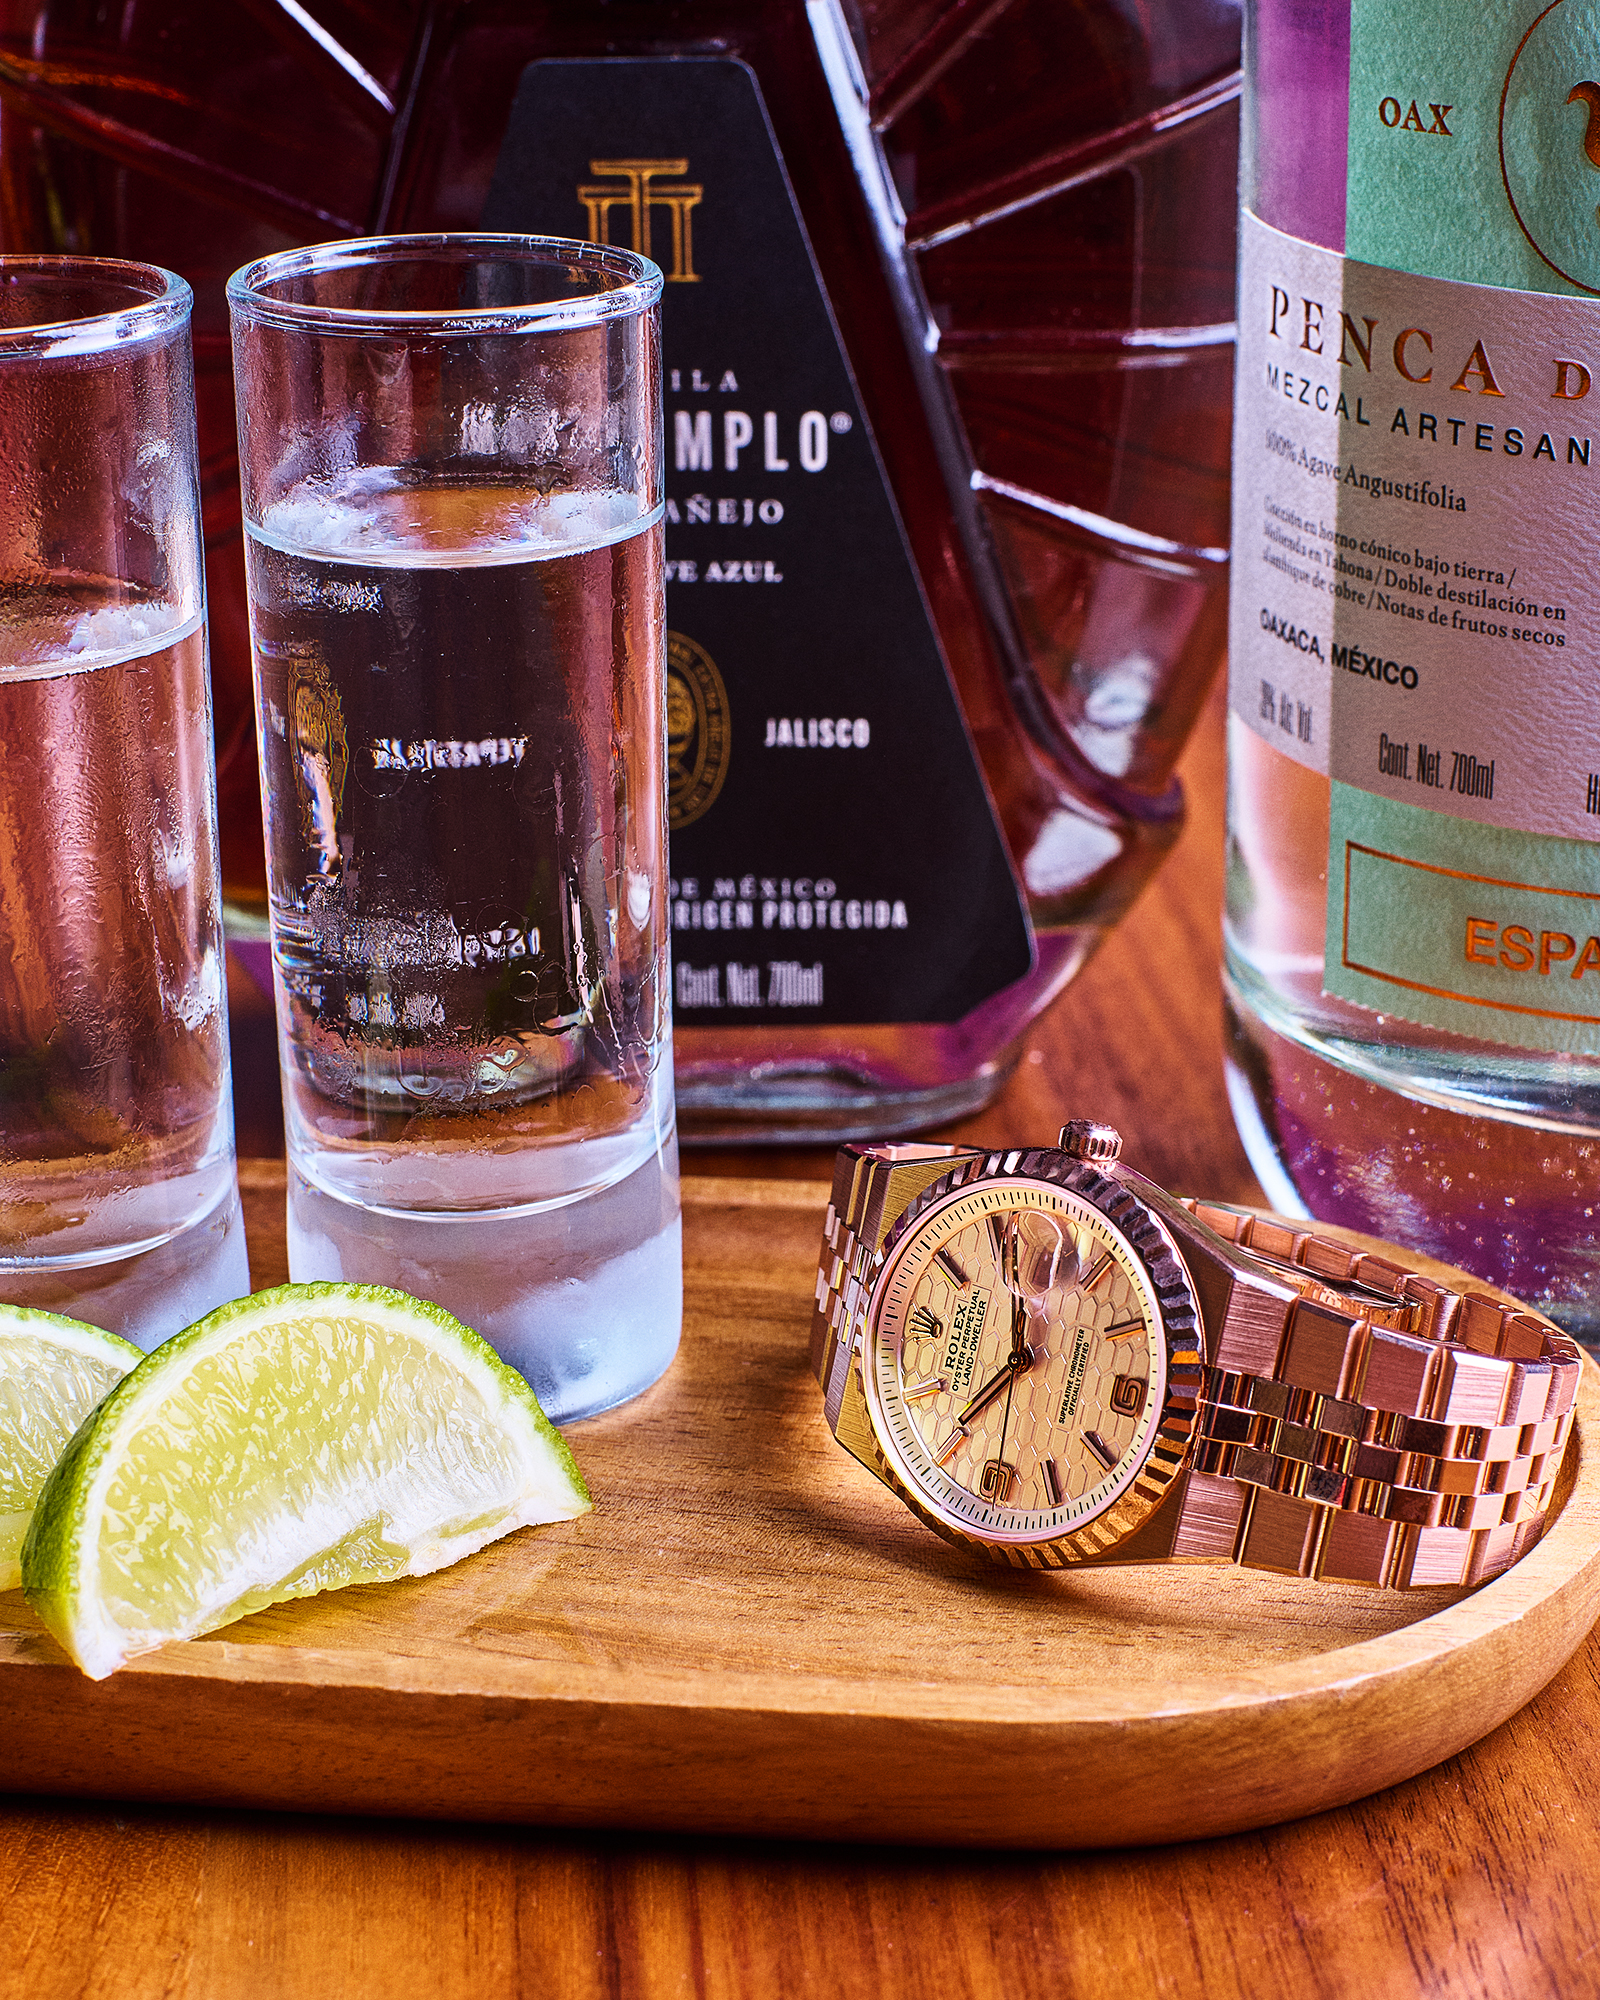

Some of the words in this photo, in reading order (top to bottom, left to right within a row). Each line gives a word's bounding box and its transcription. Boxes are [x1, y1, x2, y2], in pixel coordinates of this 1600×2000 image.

[1378, 96, 1453, 136] OAX
[1268, 284, 1506, 398] PENCA
[1551, 358, 1592, 400] D
[671, 368, 739, 392] ILA
[1267, 362, 1371, 426] MEZCAL
[1390, 408, 1592, 466] ARTESAN
[666, 493, 784, 527] AÑEJO
[1298, 446, 1341, 482] Agave
[1343, 464, 1467, 513] Angustifolia
[666, 560, 698, 583] VE
[704, 560, 784, 583] AZUL
[1319, 520, 1357, 550] horno
[1359, 538, 1411, 566] cónico
[1414, 548, 1450, 577] bajo
[1453, 561, 1505, 585] tierra
[1324, 547, 1373, 581] Tahona
[1384, 568, 1433, 597] Doble
[1436, 581, 1539, 618] destilación
[1543, 605, 1566, 621] en
[1328, 580, 1366, 606] cobre
[1376, 591, 1425, 621] Notas
[1428, 605, 1448, 627] de
[1452, 610, 1508, 638] frutos
[1511, 627, 1566, 647] secos
[1260, 607, 1325, 665] OAXACA,
[1331, 644, 1419, 690] MÉXICO
[764, 717, 871, 748] JALISCO
[1378, 732, 1412, 781] Cont.
[1416, 743, 1444, 789] Net.
[1449, 752, 1495, 800] 700ml
[671, 900, 754, 930] RIGEN
[762, 900, 909, 930] PROTEGIDA
[713, 873, 837, 900] MÉXICO
[945, 1303, 968, 1370] ROLEX
[951, 1350, 966, 1392] OYSTER
[961, 1289, 980, 1350] PERPETUAL
[962, 1300, 987, 1387] LAND-DWELLER
[1058, 1379, 1074, 1424] SUPERLATIVE
[1068, 1328, 1085, 1379] CHRONOMETER
[1067, 1377, 1082, 1416] OFFICIALLY
[1076, 1341, 1090, 1377] CERTIFIED
[1109, 1374, 1145, 1418] 6
[979, 1459, 1012, 1501] 9
